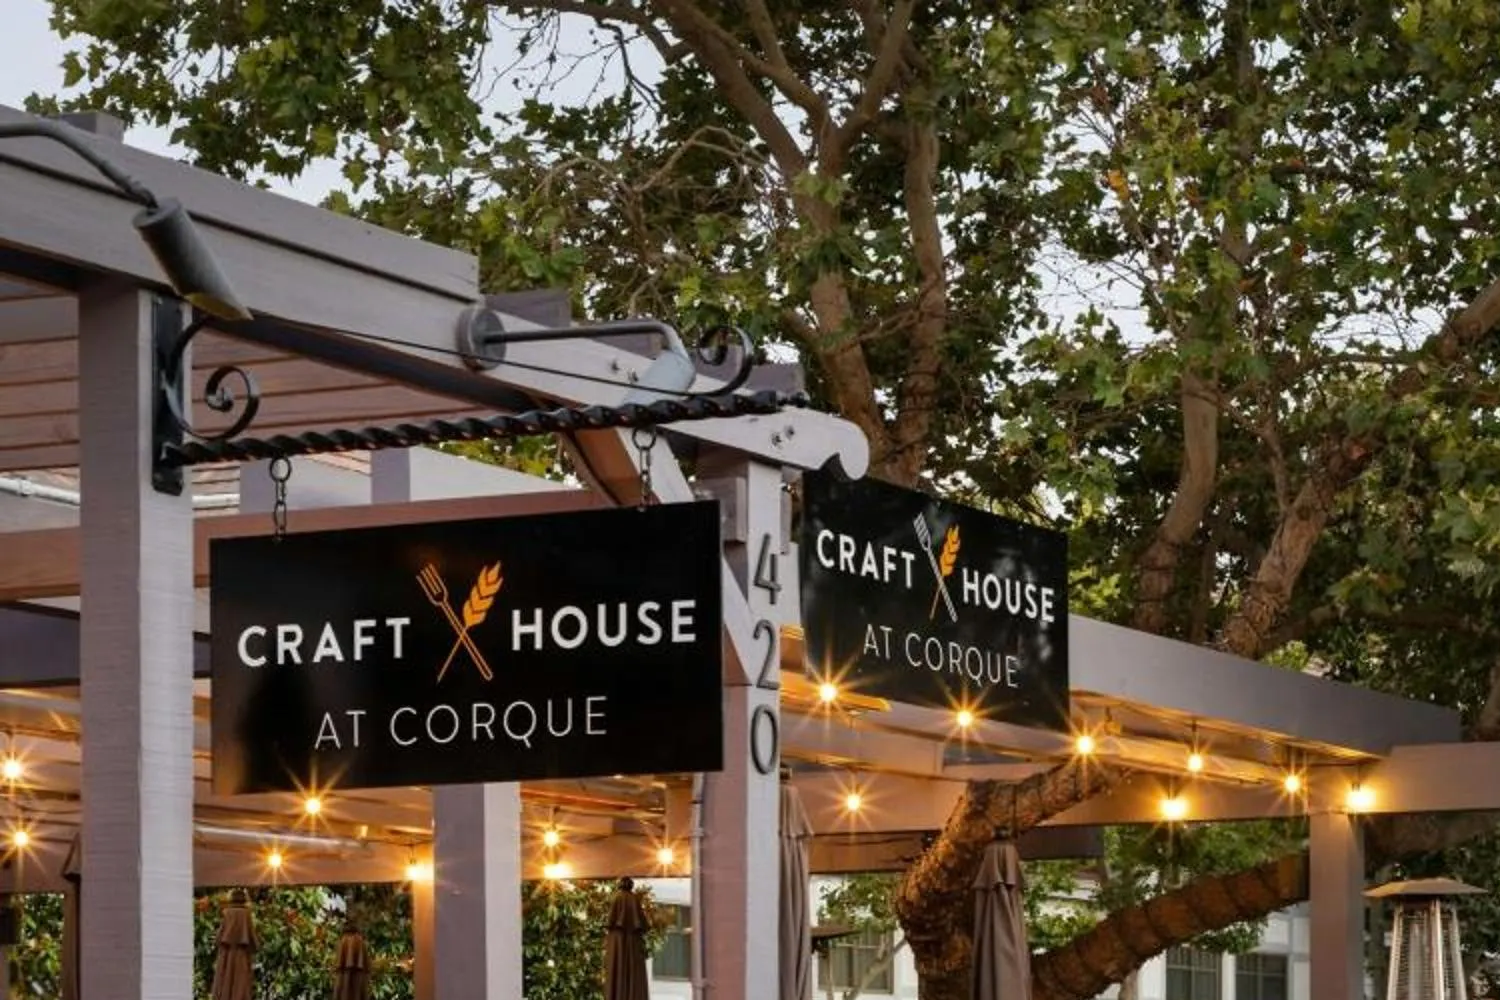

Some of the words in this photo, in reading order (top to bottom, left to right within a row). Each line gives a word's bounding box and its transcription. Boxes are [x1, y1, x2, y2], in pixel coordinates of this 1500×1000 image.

[817, 529, 915, 588] CRAFT
[962, 567, 1055, 622] HOUSE
[237, 617, 411, 667] CRAFT
[512, 599, 696, 651] HOUSE
[751, 533, 781, 775] 420
[863, 623, 893, 660] AT
[905, 632, 1019, 688] CORQUE
[314, 710, 366, 749] AT
[389, 695, 607, 749] CORQUE
